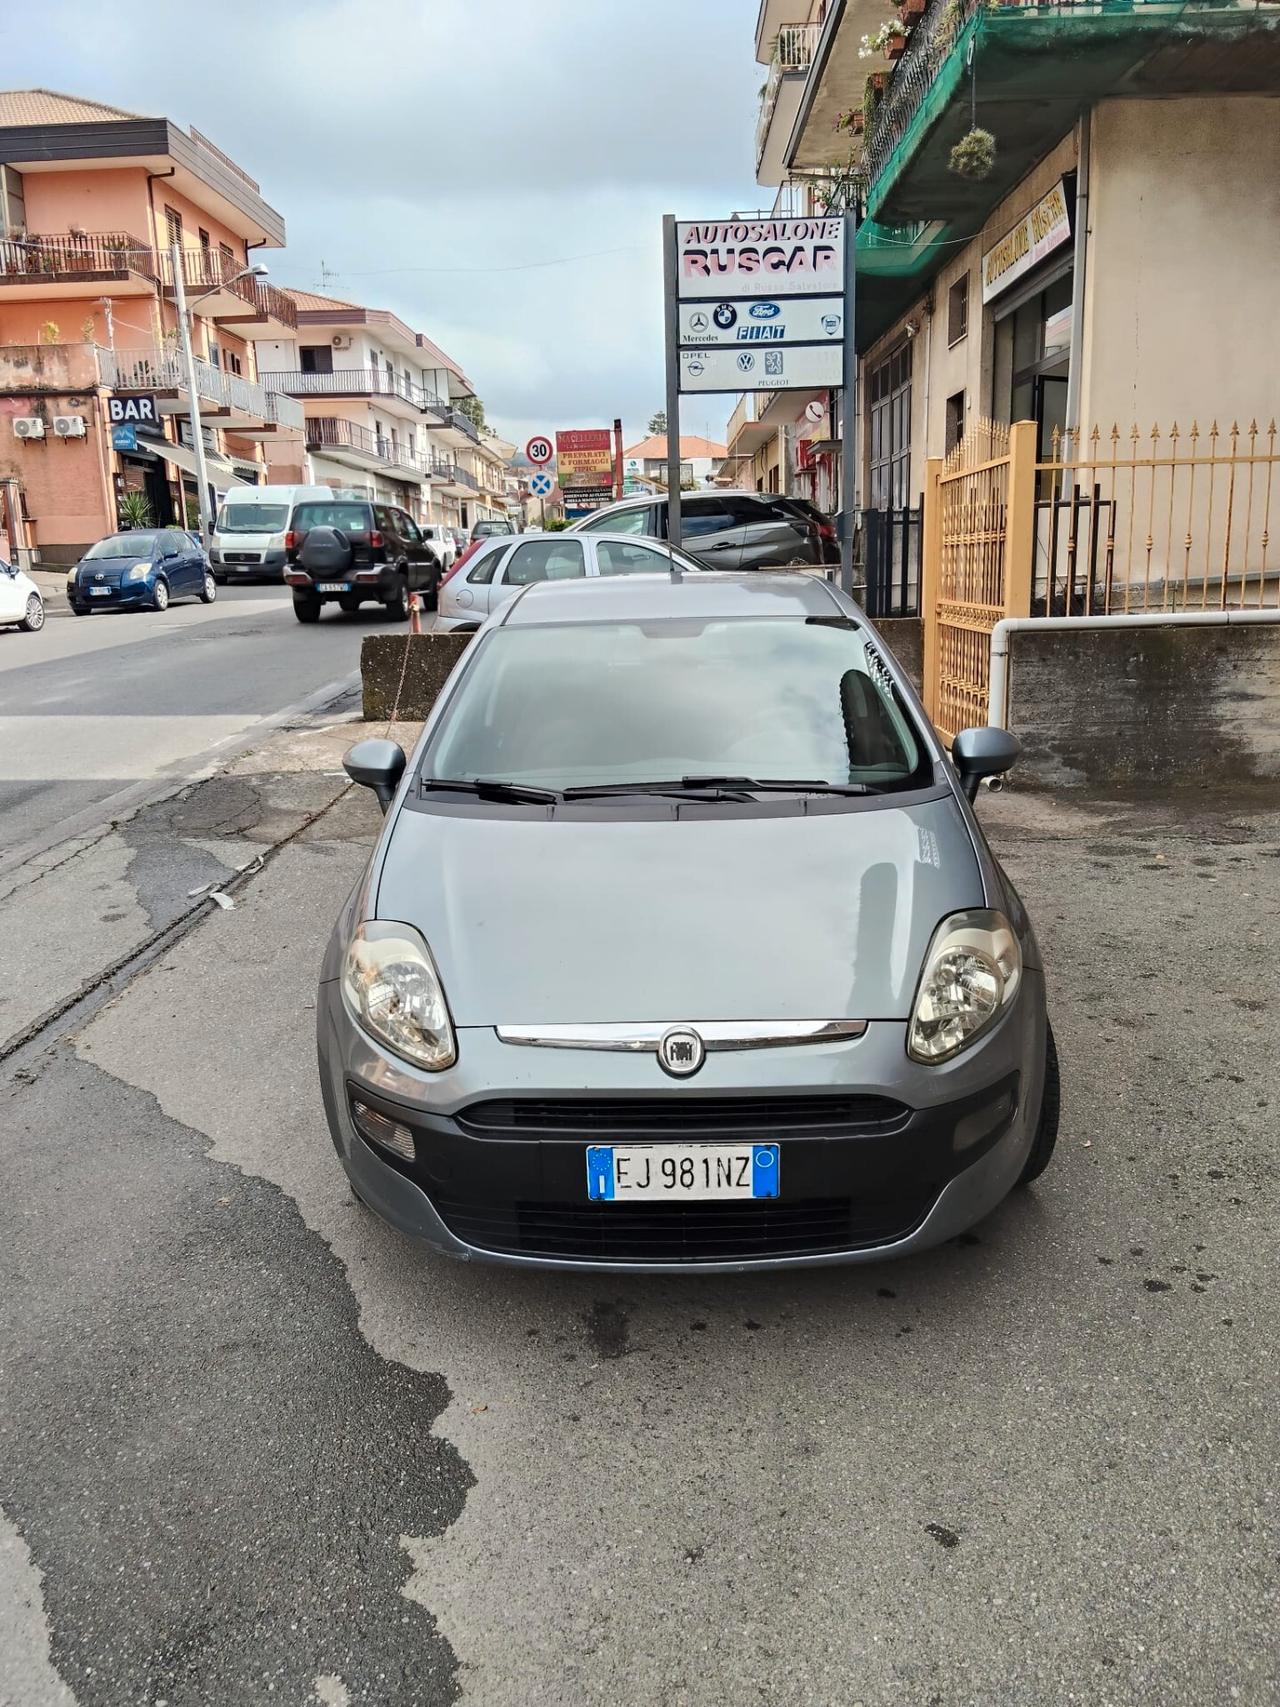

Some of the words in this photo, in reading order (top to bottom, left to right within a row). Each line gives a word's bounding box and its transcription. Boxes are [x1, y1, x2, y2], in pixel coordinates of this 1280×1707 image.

[686, 221, 840, 244] AUTOSALONE
[683, 246, 838, 277] RUSCAR
[752, 305, 775, 317] Ford
[682, 334, 719, 342] Mercedes
[737, 325, 785, 340] FIAT
[758, 379, 789, 387] PEUGEOT
[110, 399, 154, 421] BAR
[532, 444, 547, 458] 30
[562, 451, 606, 459] PREPARATI
[567, 458, 609, 466] FORMAGGI
